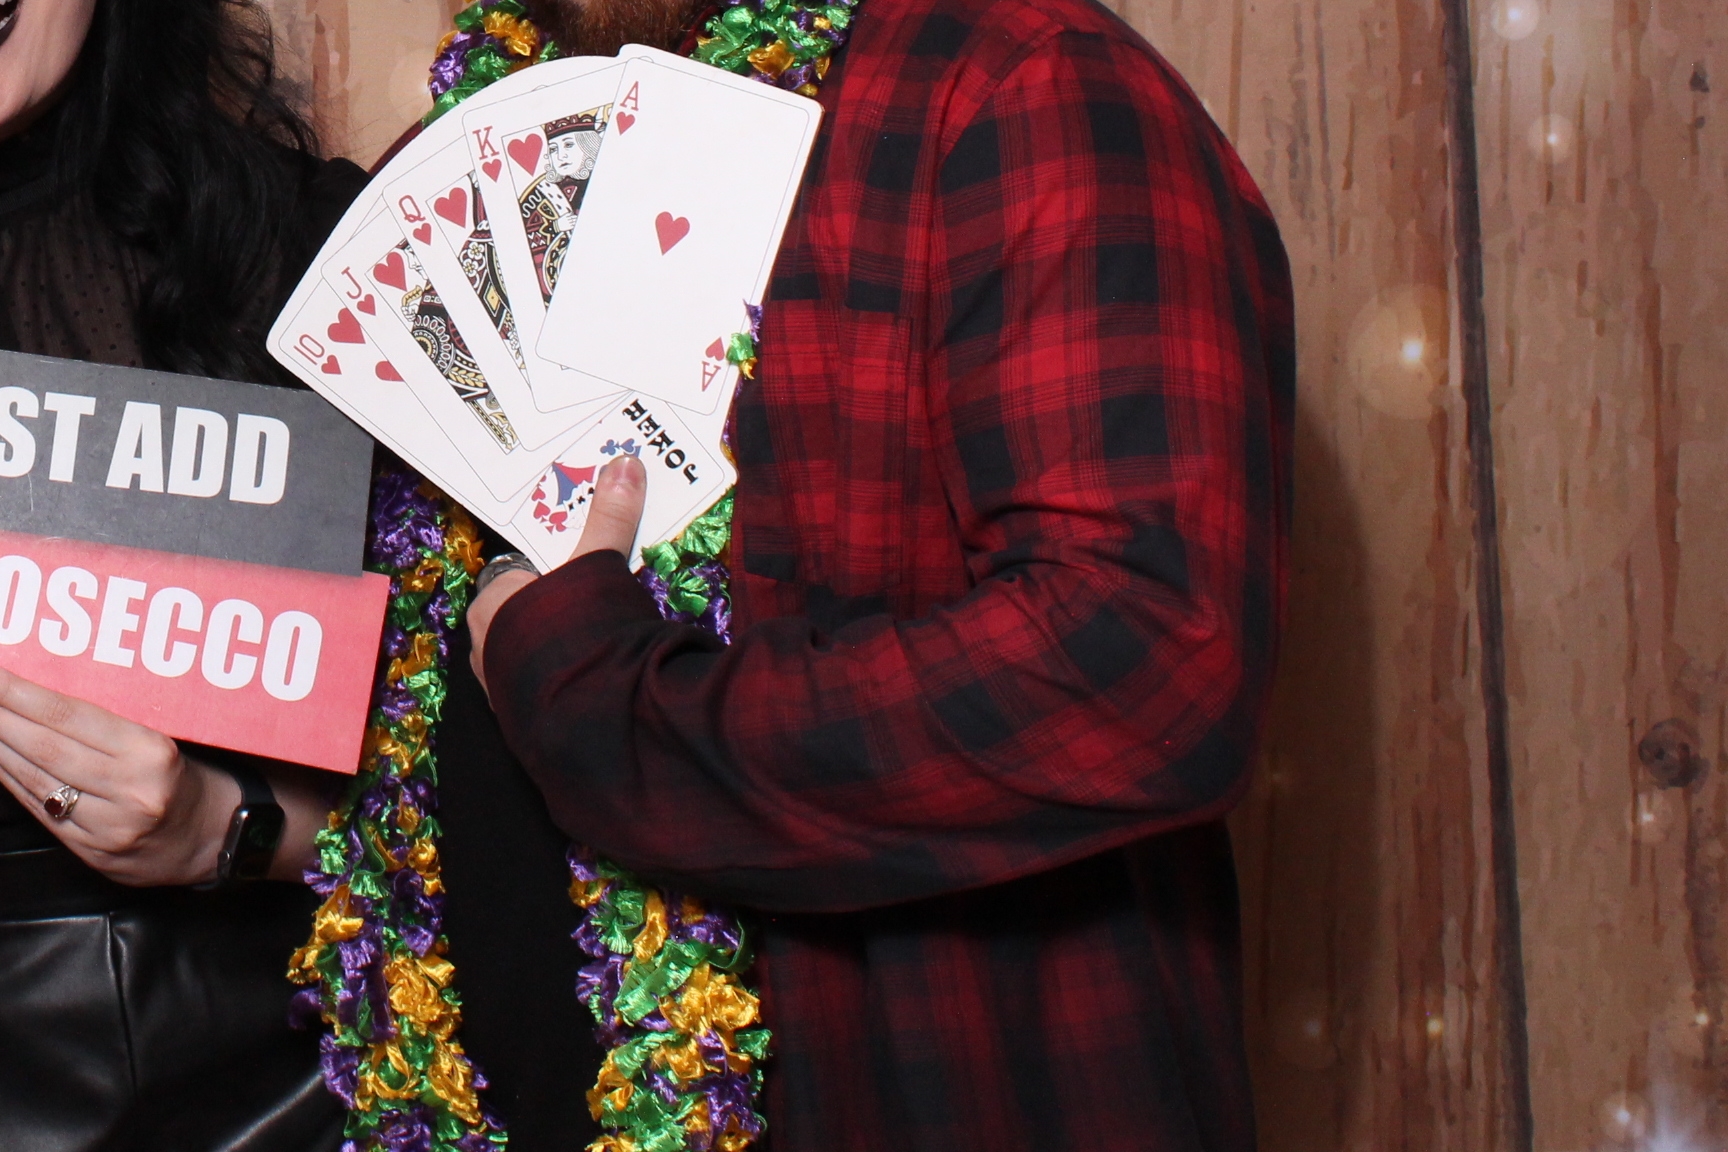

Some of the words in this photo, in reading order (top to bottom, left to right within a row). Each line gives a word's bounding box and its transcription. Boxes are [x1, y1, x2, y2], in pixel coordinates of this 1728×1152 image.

[619, 81, 640, 111] A
[473, 126, 500, 160] K
[398, 195, 426, 223] Q
[341, 266, 362, 299] J
[293, 334, 325, 365] 10
[701, 361, 721, 393] A
[105, 401, 291, 505] ADD
[622, 398, 698, 485] JOKER
